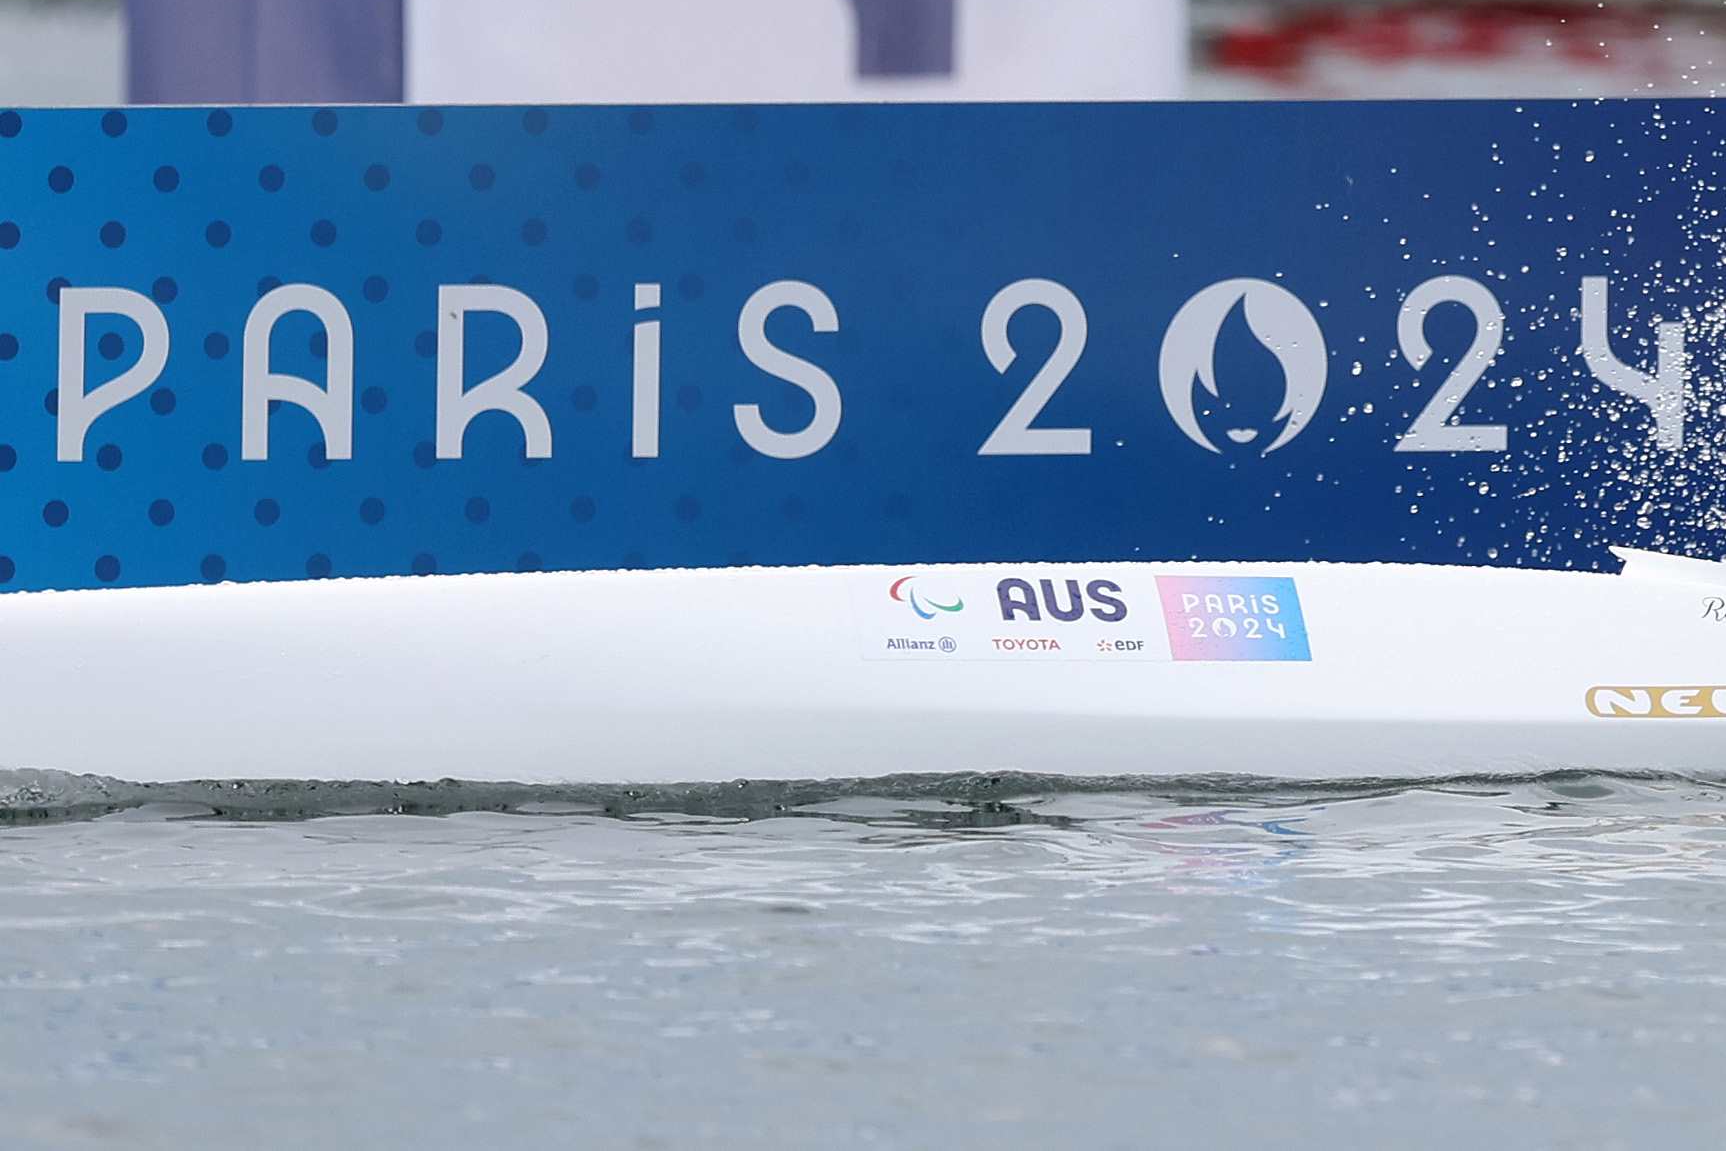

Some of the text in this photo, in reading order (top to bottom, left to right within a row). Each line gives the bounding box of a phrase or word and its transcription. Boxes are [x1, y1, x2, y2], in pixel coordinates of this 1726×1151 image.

[56, 274, 1685, 461] PARIS 2024
[996, 577, 1128, 622] AUS
[1181, 593, 1280, 614] PARIS
[1188, 617, 1286, 639] 2024
[887, 637, 936, 651] Allianz
[992, 638, 1061, 651] TOYOTA
